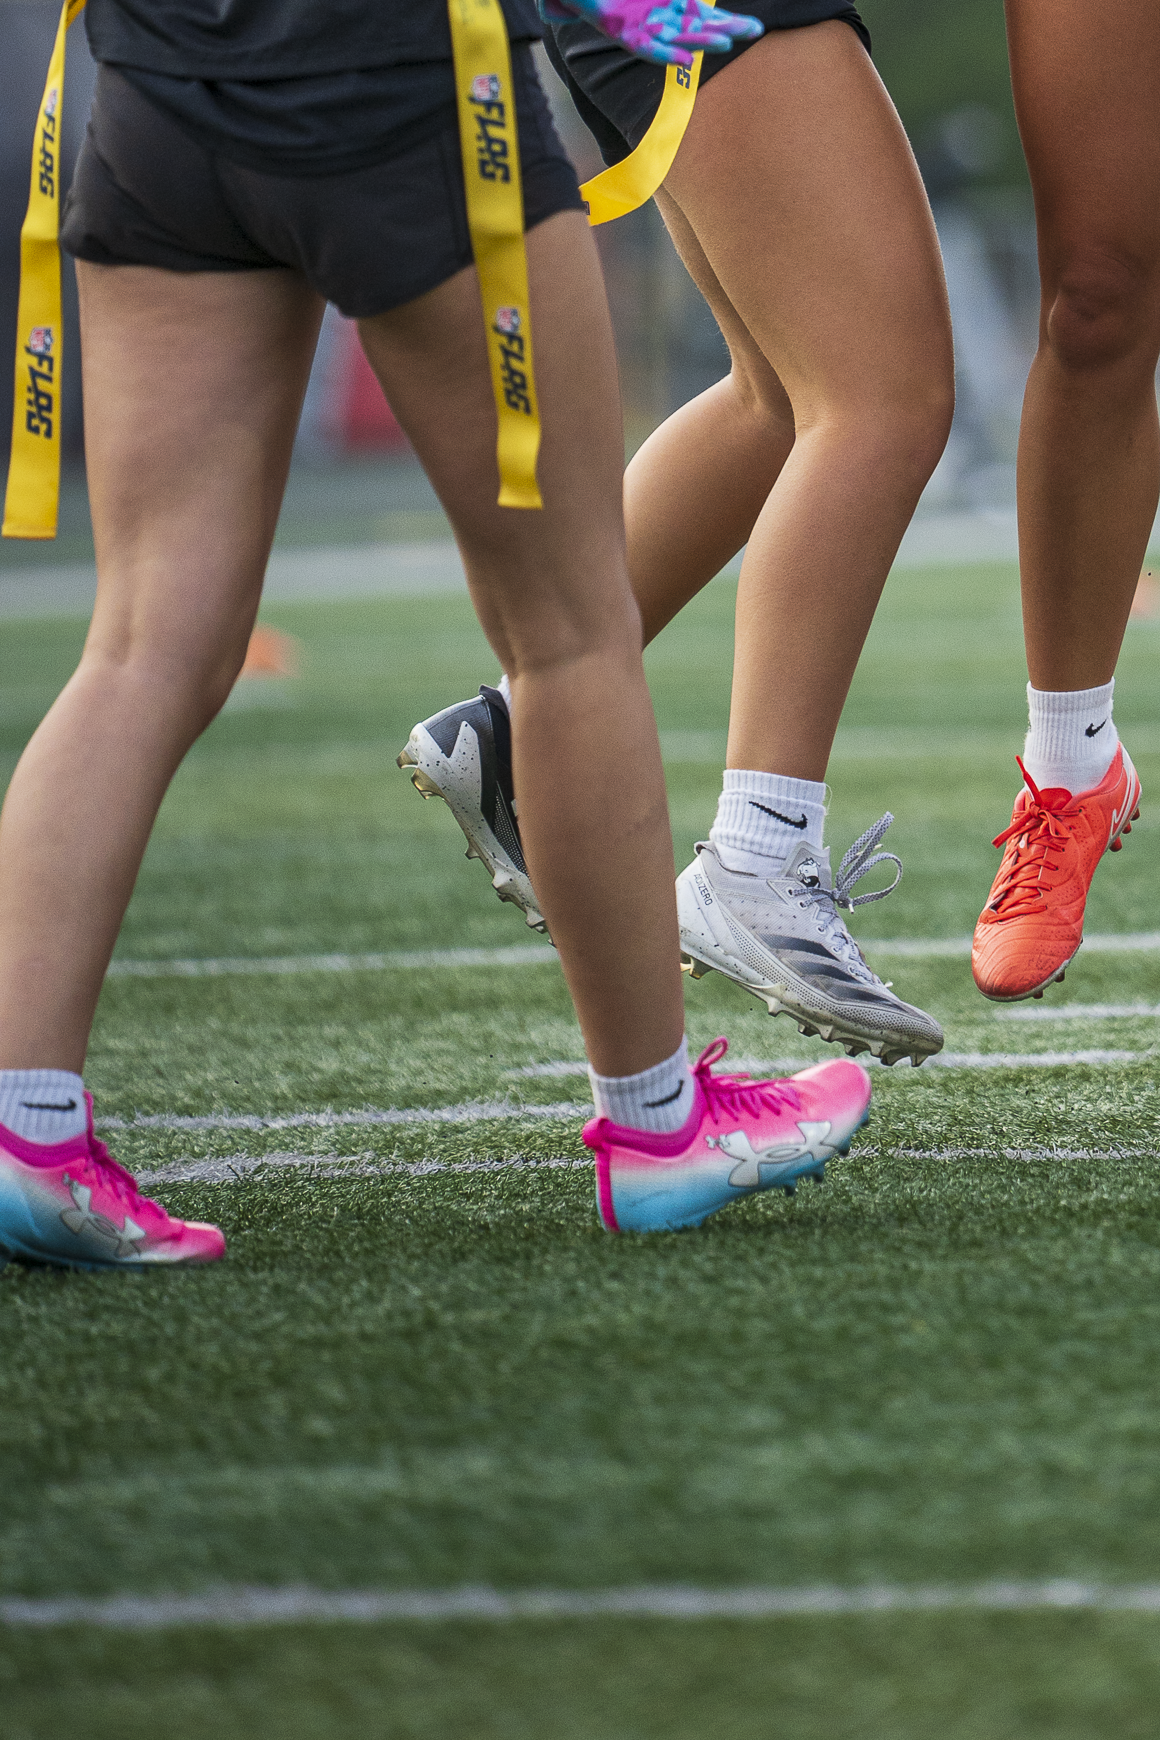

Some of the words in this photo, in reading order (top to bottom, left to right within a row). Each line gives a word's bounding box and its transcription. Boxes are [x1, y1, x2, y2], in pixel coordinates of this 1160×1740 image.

[467, 94, 511, 184] FLAG
[24, 344, 54, 439] FLAG
[491, 324, 532, 416] FLAG
